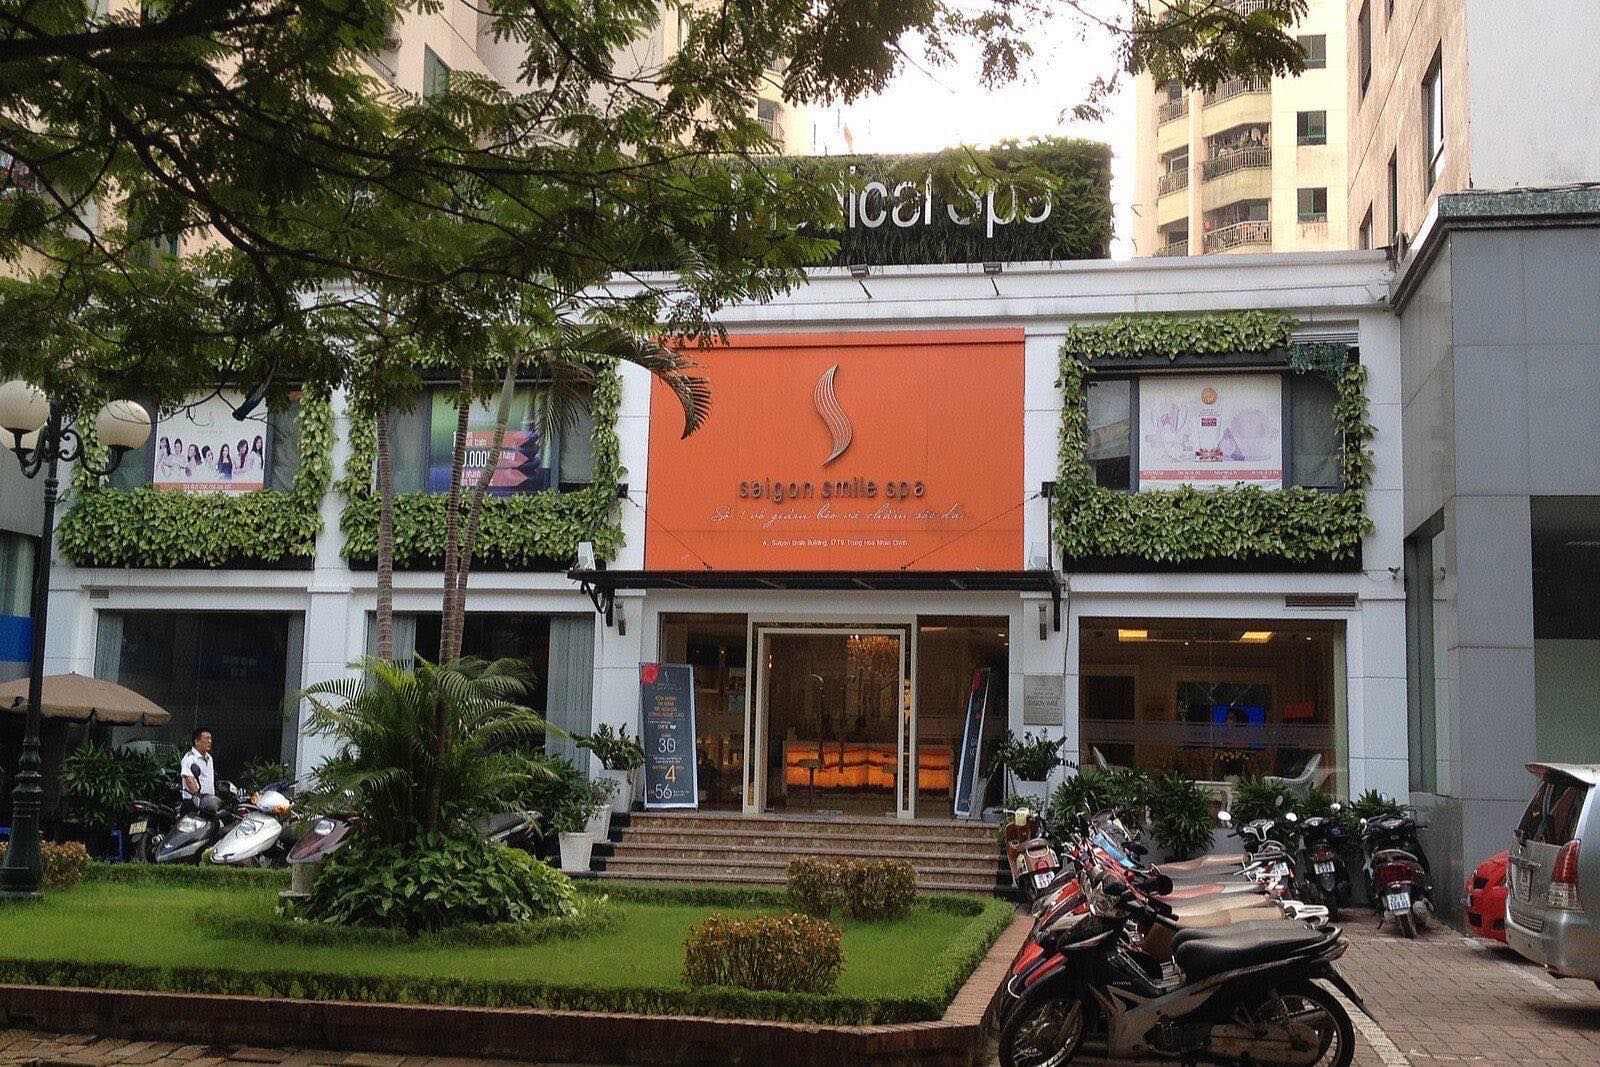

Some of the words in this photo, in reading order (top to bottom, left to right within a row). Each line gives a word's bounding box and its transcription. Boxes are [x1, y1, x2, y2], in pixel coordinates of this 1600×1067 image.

[739, 477, 815, 504] saigon
[821, 477, 877, 499] smile
[884, 480, 926, 502] spa
[658, 738, 676, 753] 30
[665, 765, 677, 783] 4
[655, 784, 673, 799] 56
